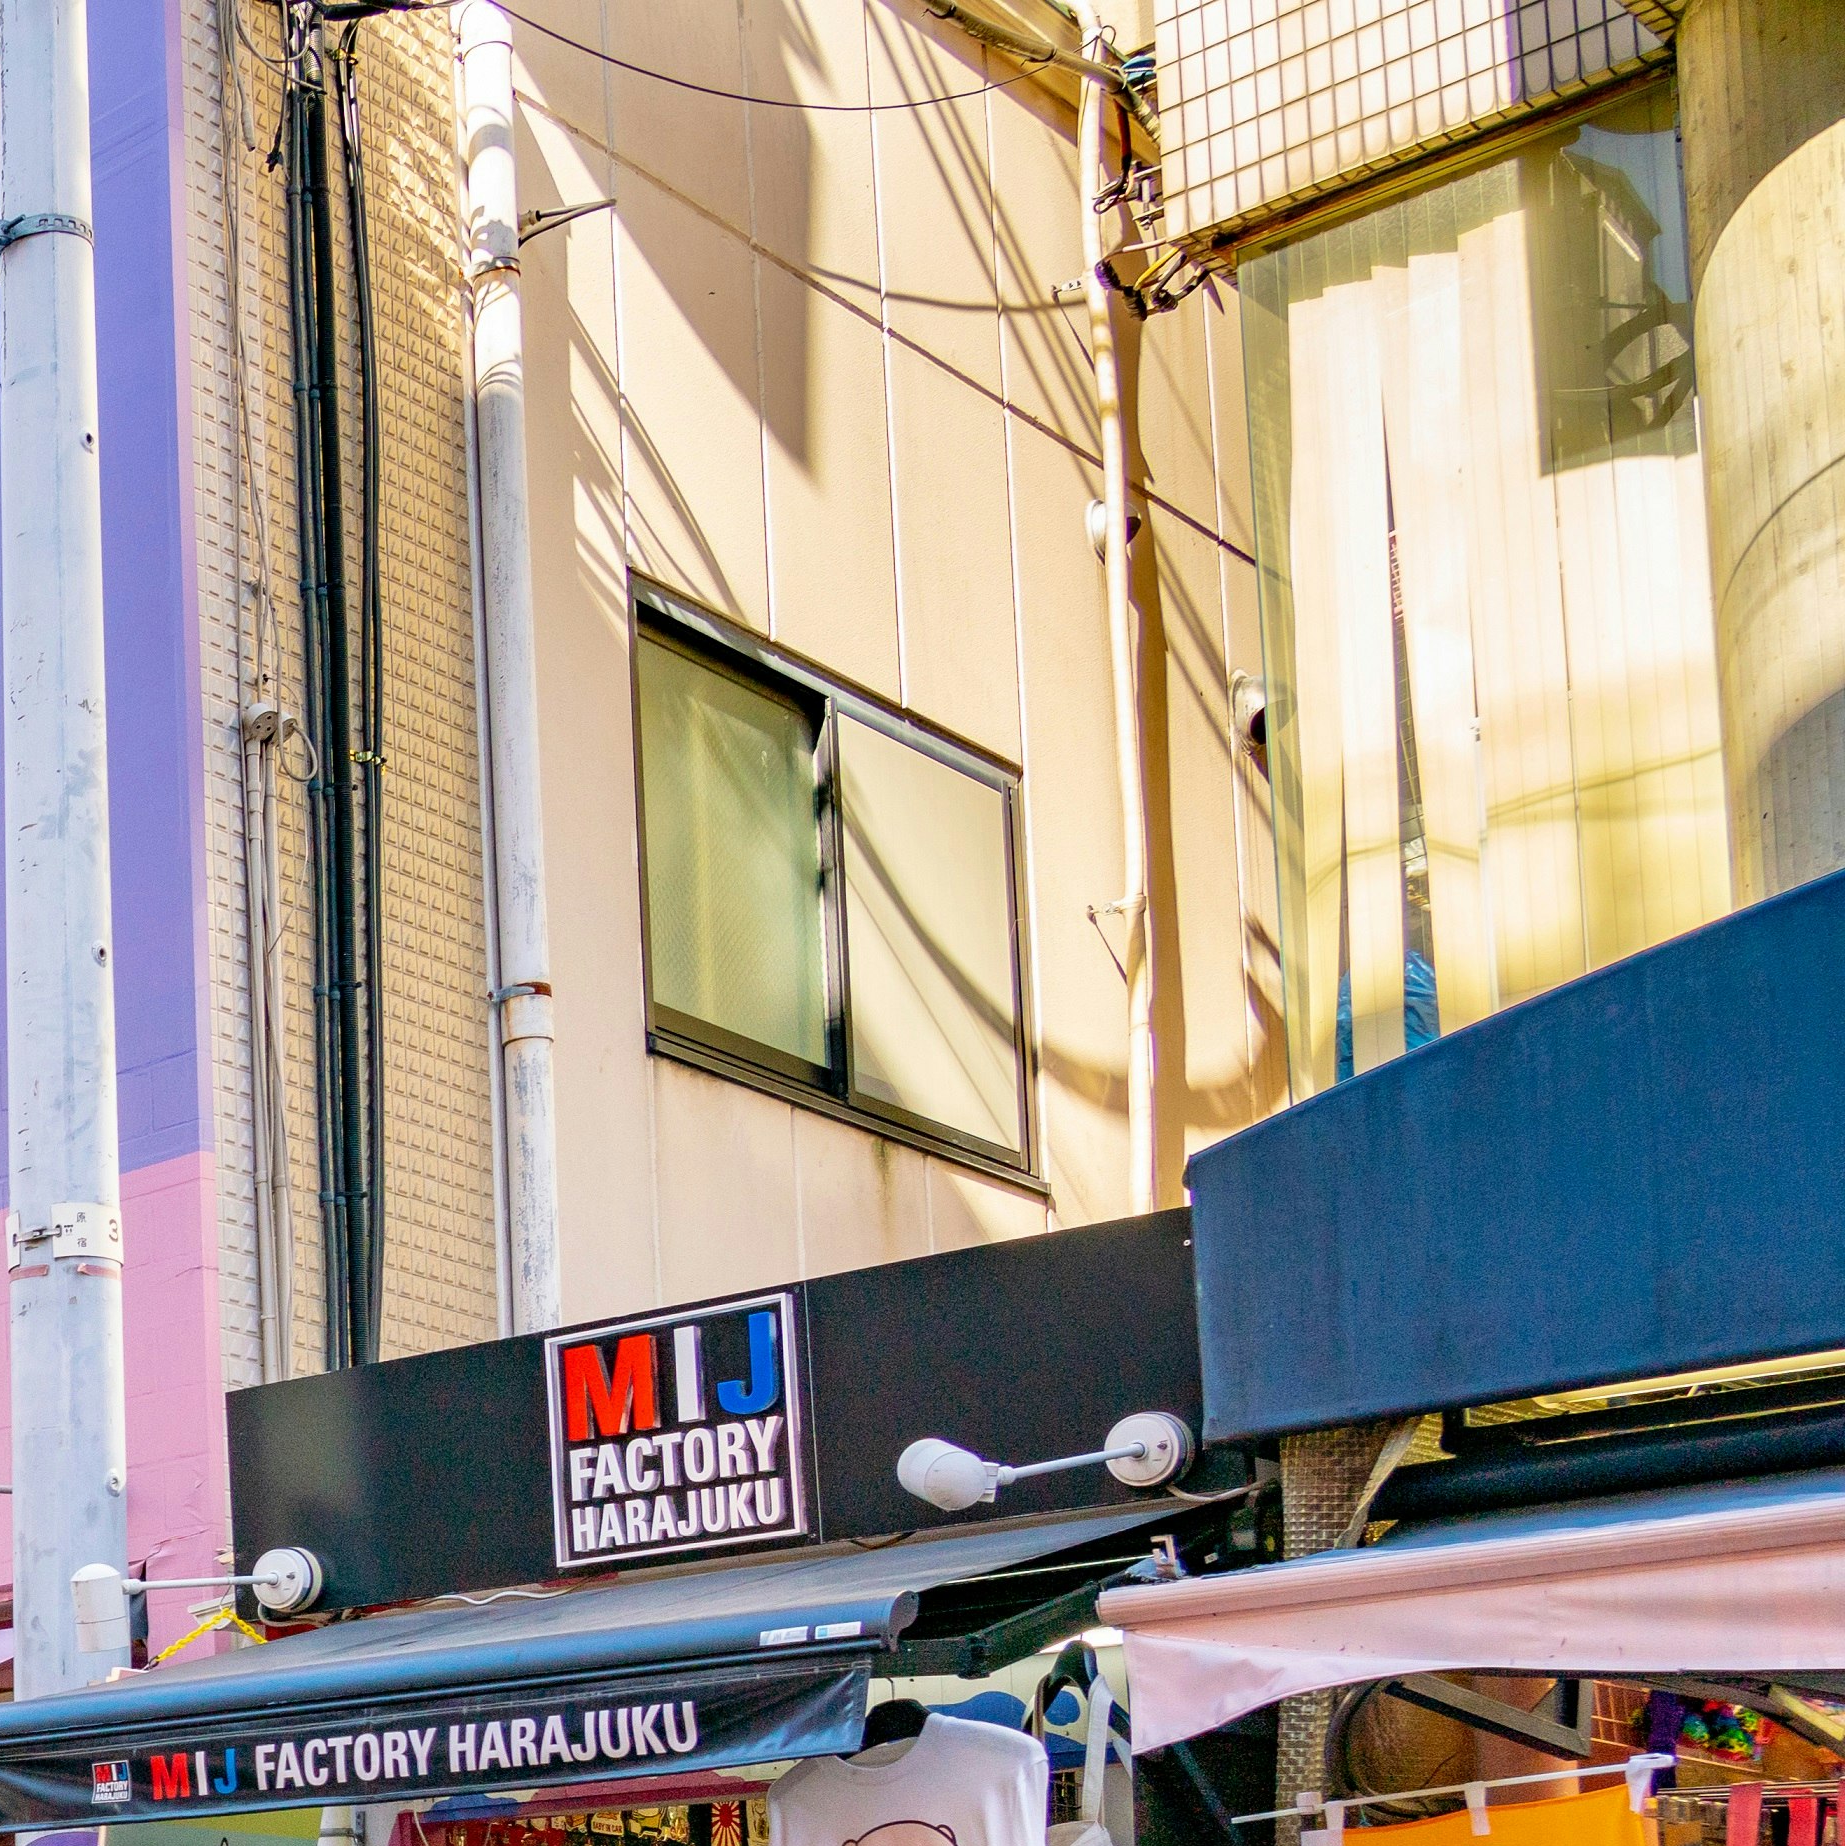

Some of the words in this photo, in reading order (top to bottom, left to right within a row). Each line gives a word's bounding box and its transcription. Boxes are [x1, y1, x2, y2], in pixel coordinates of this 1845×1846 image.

[565, 1310, 780, 1443] MIJ
[569, 1415, 778, 1502] FACTORY
[570, 1475, 786, 1555] HARAJUKU
[151, 1747, 238, 1800] MIJ
[255, 1727, 438, 1791] FACTORY
[448, 1700, 699, 1773] HARAJUKU
